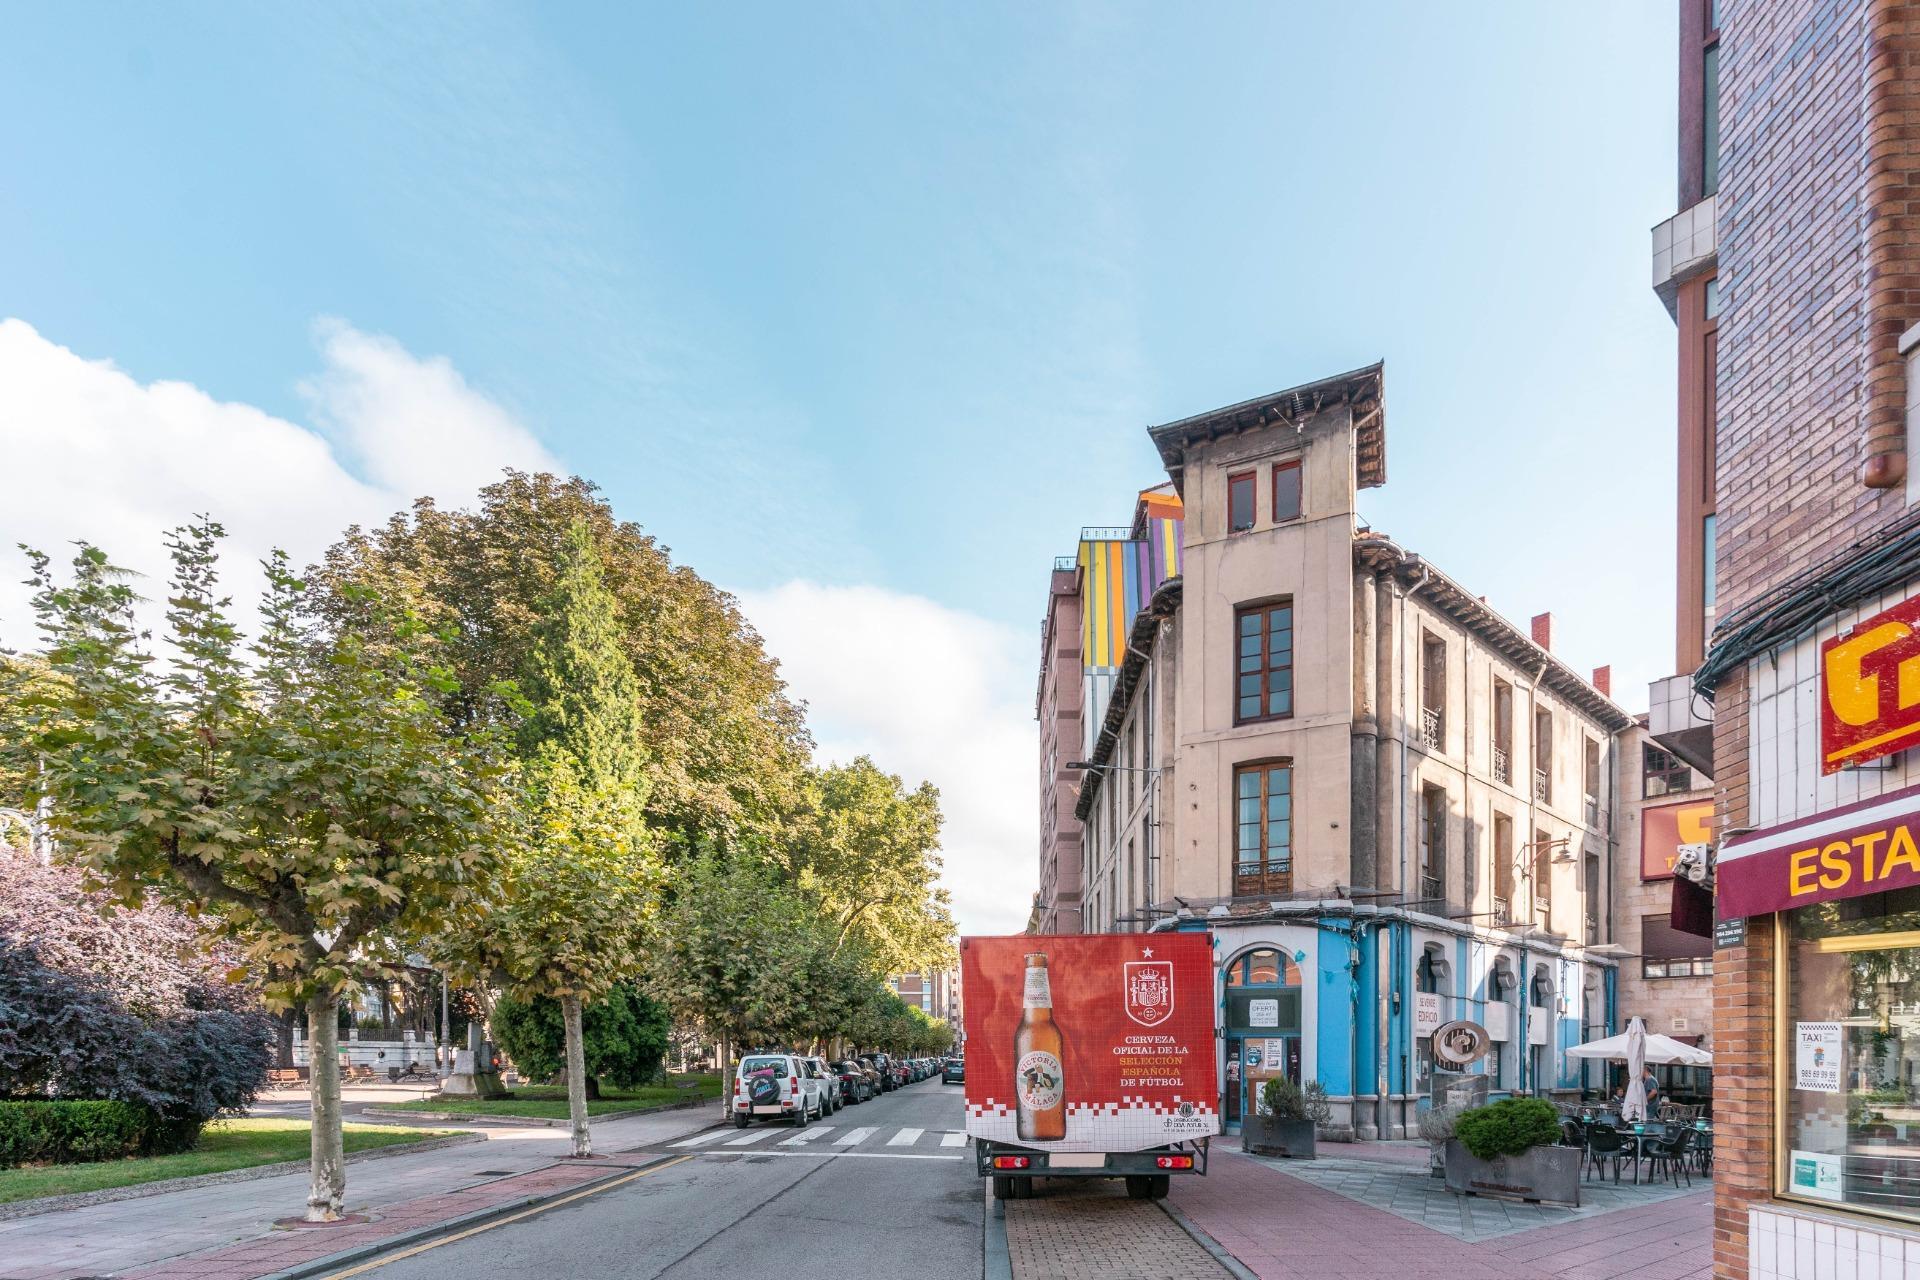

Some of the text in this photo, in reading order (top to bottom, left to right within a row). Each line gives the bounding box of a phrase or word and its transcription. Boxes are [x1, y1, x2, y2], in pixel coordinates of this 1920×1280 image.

[1418, 1010, 1438, 1023] EDIFICIO
[1125, 1036, 1176, 1044] CERVEZA
[1801, 1033, 1822, 1042] TAXI
[1112, 1046, 1189, 1055] OFICIAL DE LA
[1020, 1056, 1057, 1072] VICTORIA
[1119, 1055, 1183, 1065] SELECCIÓN
[1122, 1066, 1181, 1076] ESPAÑOLA
[1120, 1076, 1184, 1087] DE FÚTBOL
[1024, 1092, 1058, 1106] MÁLAGA
